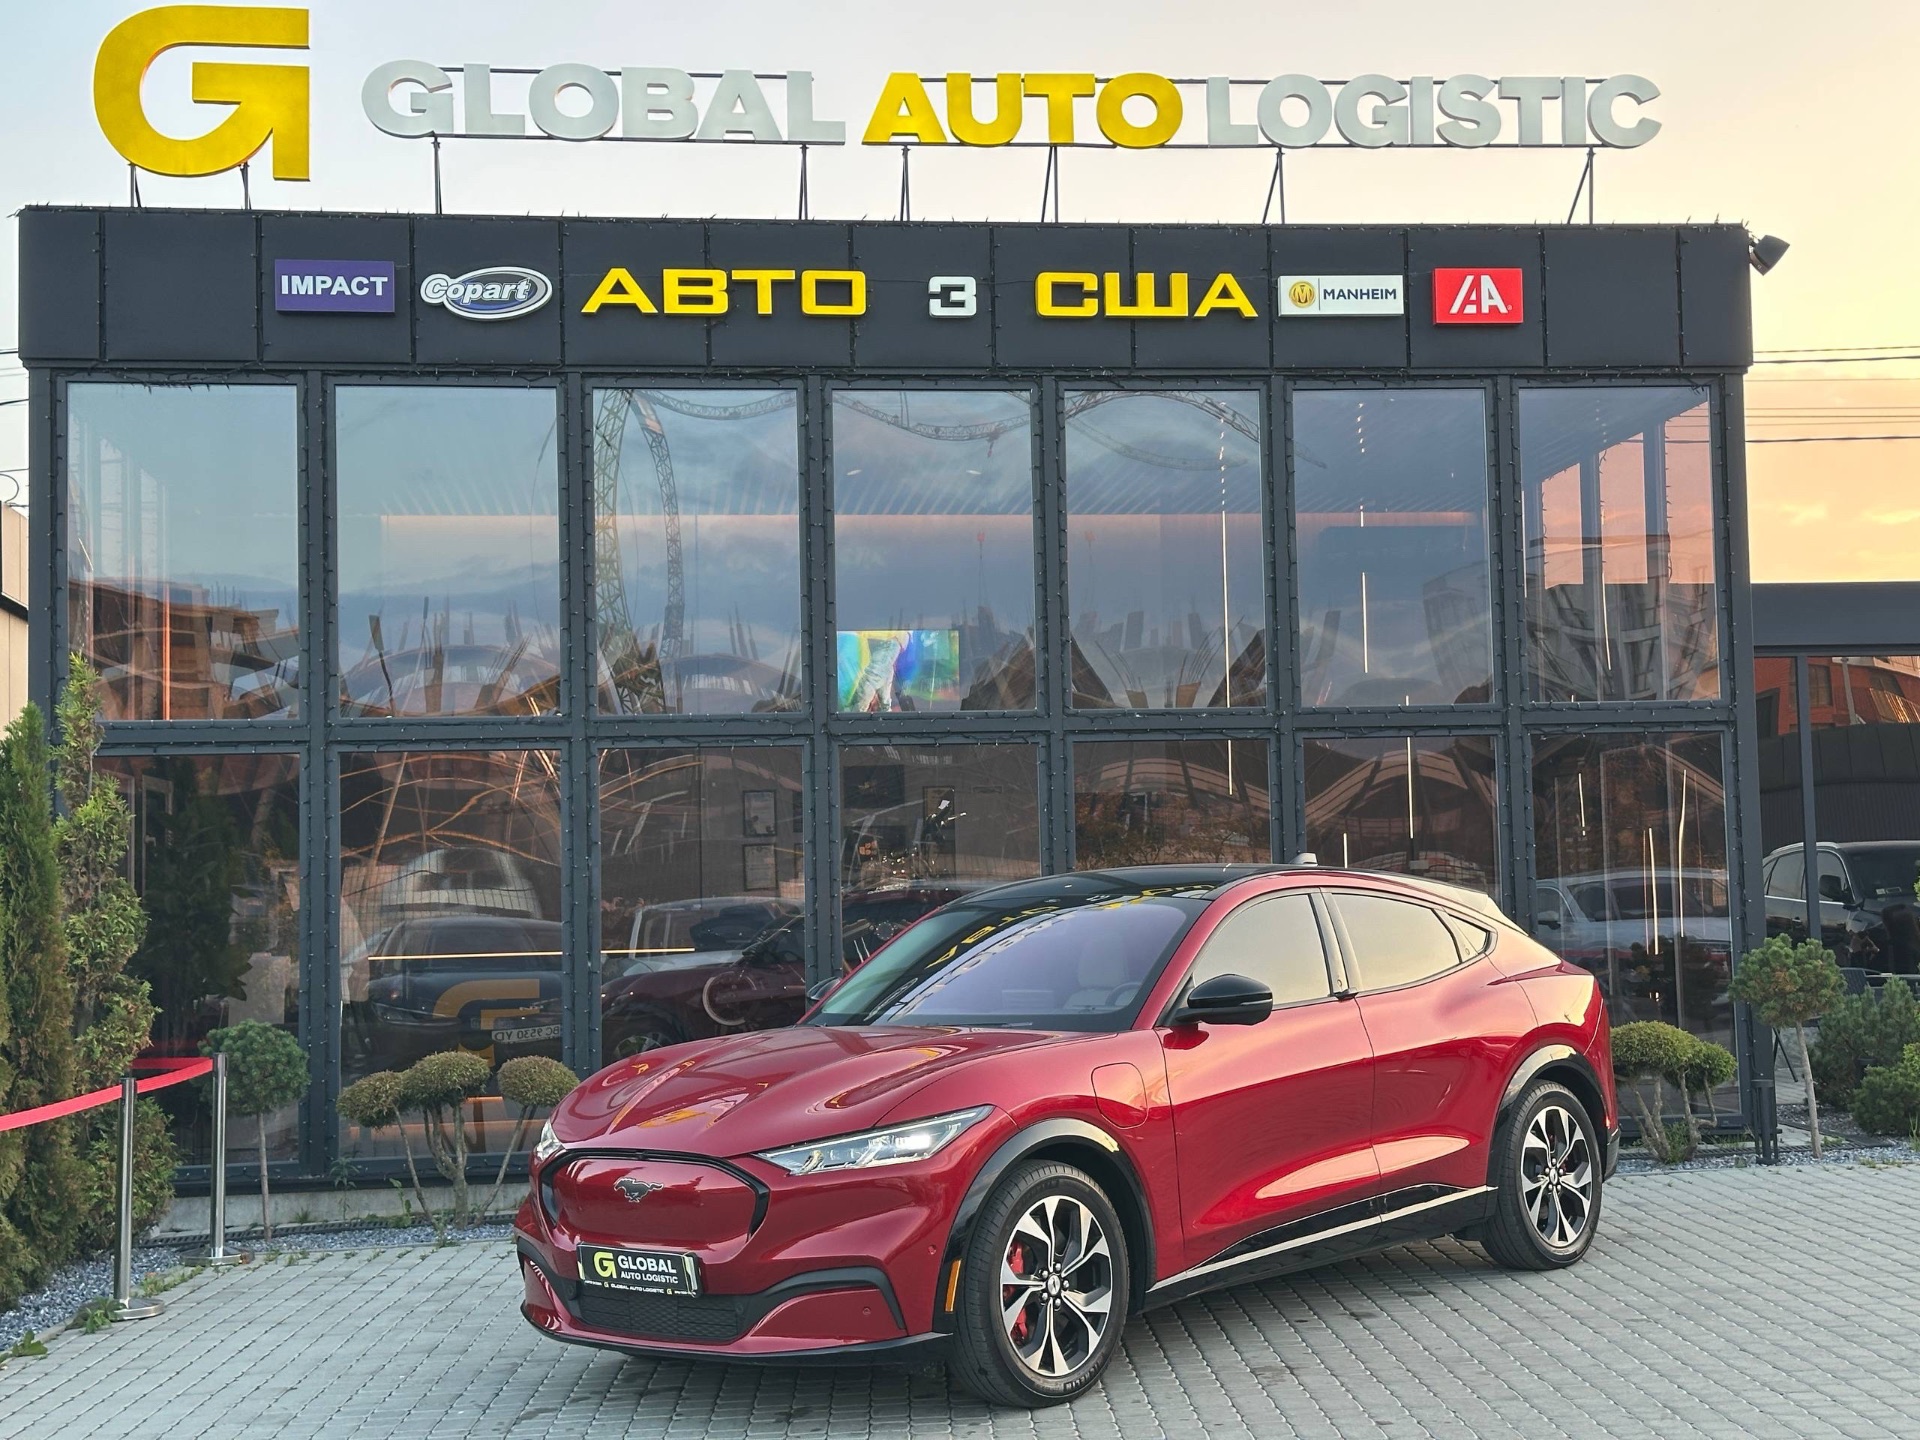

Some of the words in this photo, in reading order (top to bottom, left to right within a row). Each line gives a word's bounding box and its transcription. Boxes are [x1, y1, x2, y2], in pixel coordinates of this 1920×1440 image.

[361, 59, 845, 145] GLOBAL
[863, 72, 1183, 148] AUTO
[1207, 74, 1662, 149] LOGISTIC
[281, 274, 389, 297] IMPACT
[425, 276, 531, 305] Copart
[582, 267, 867, 316] АВТО
[1035, 271, 1257, 318] США
[1323, 288, 1397, 300] MANHEIM
[617, 1255, 677, 1273] GLOBAL
[620, 1271, 642, 1280] AUTO
[642, 1273, 679, 1284] LOGISTIC
